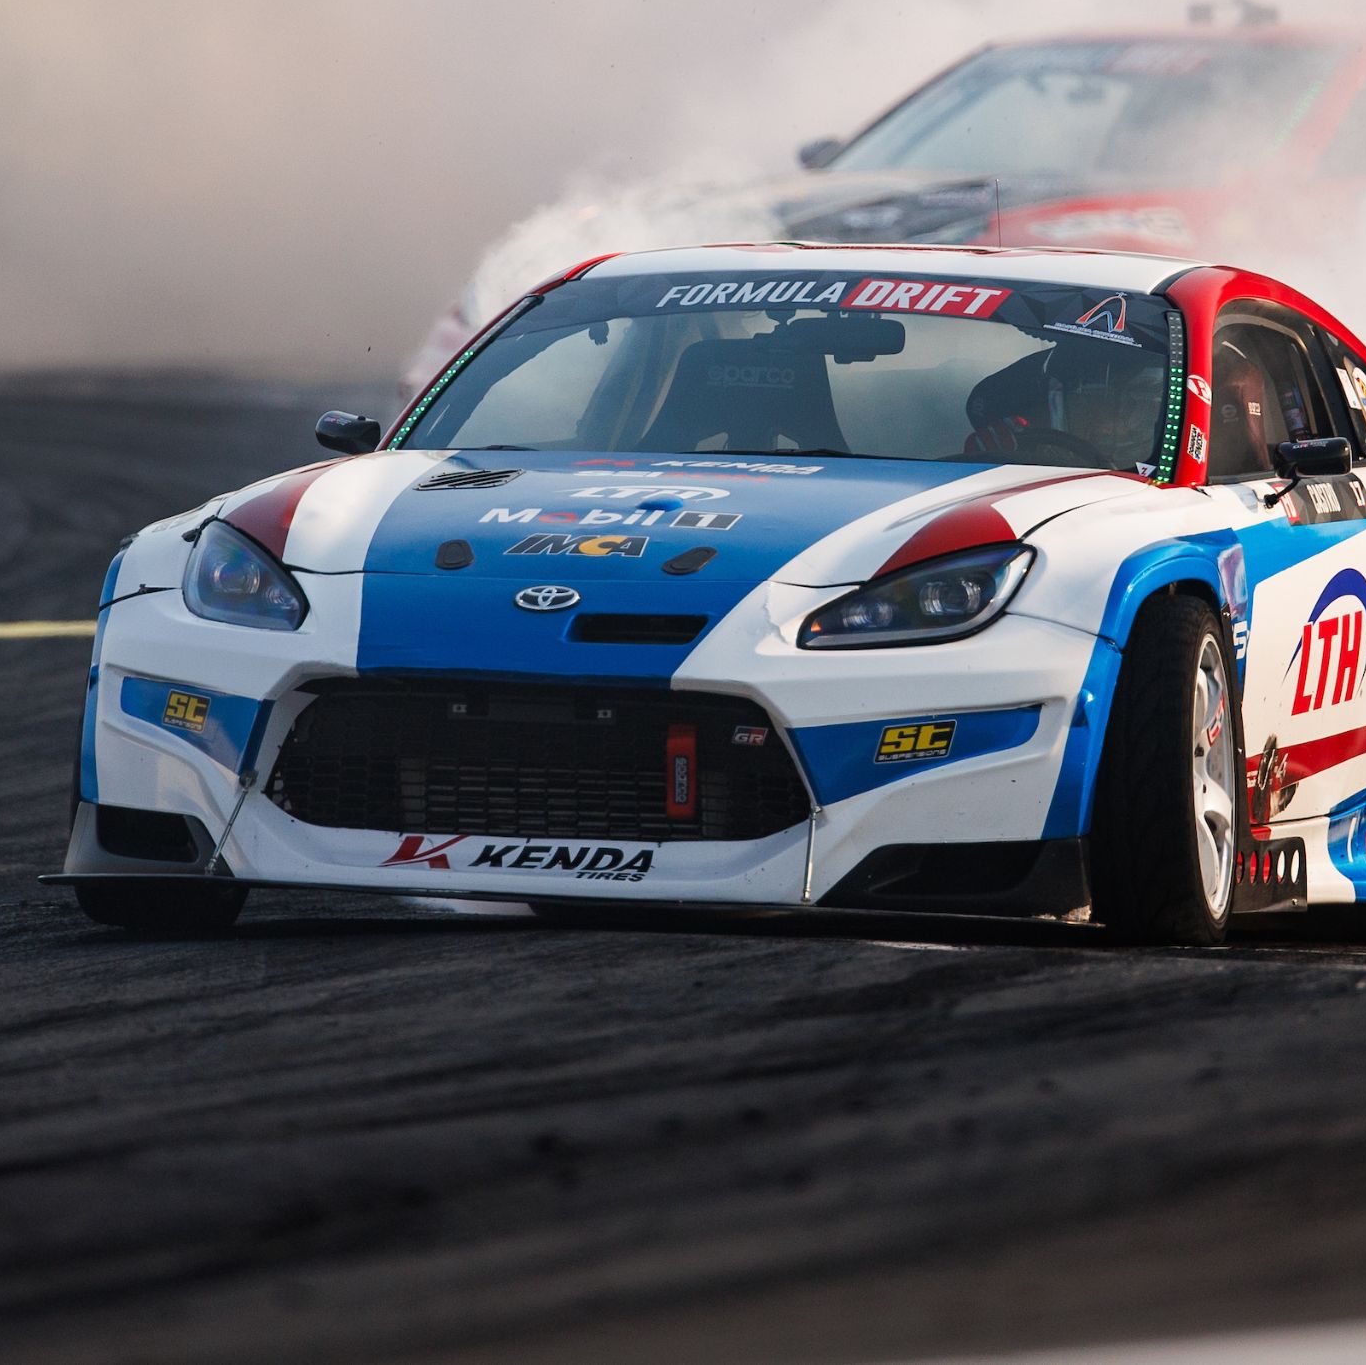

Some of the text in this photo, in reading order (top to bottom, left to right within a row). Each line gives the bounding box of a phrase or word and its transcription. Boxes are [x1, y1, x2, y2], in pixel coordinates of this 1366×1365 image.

[655, 280, 1003, 316] FORMULA DRIFT
[1348, 481, 1366, 507] 17
[479, 508, 666, 526] Mobil
[504, 533, 649, 557] IMCA
[1291, 611, 1363, 716] LTH
[734, 732, 764, 745] GR
[468, 844, 655, 873] KENDA
[575, 871, 646, 883] TIRES
